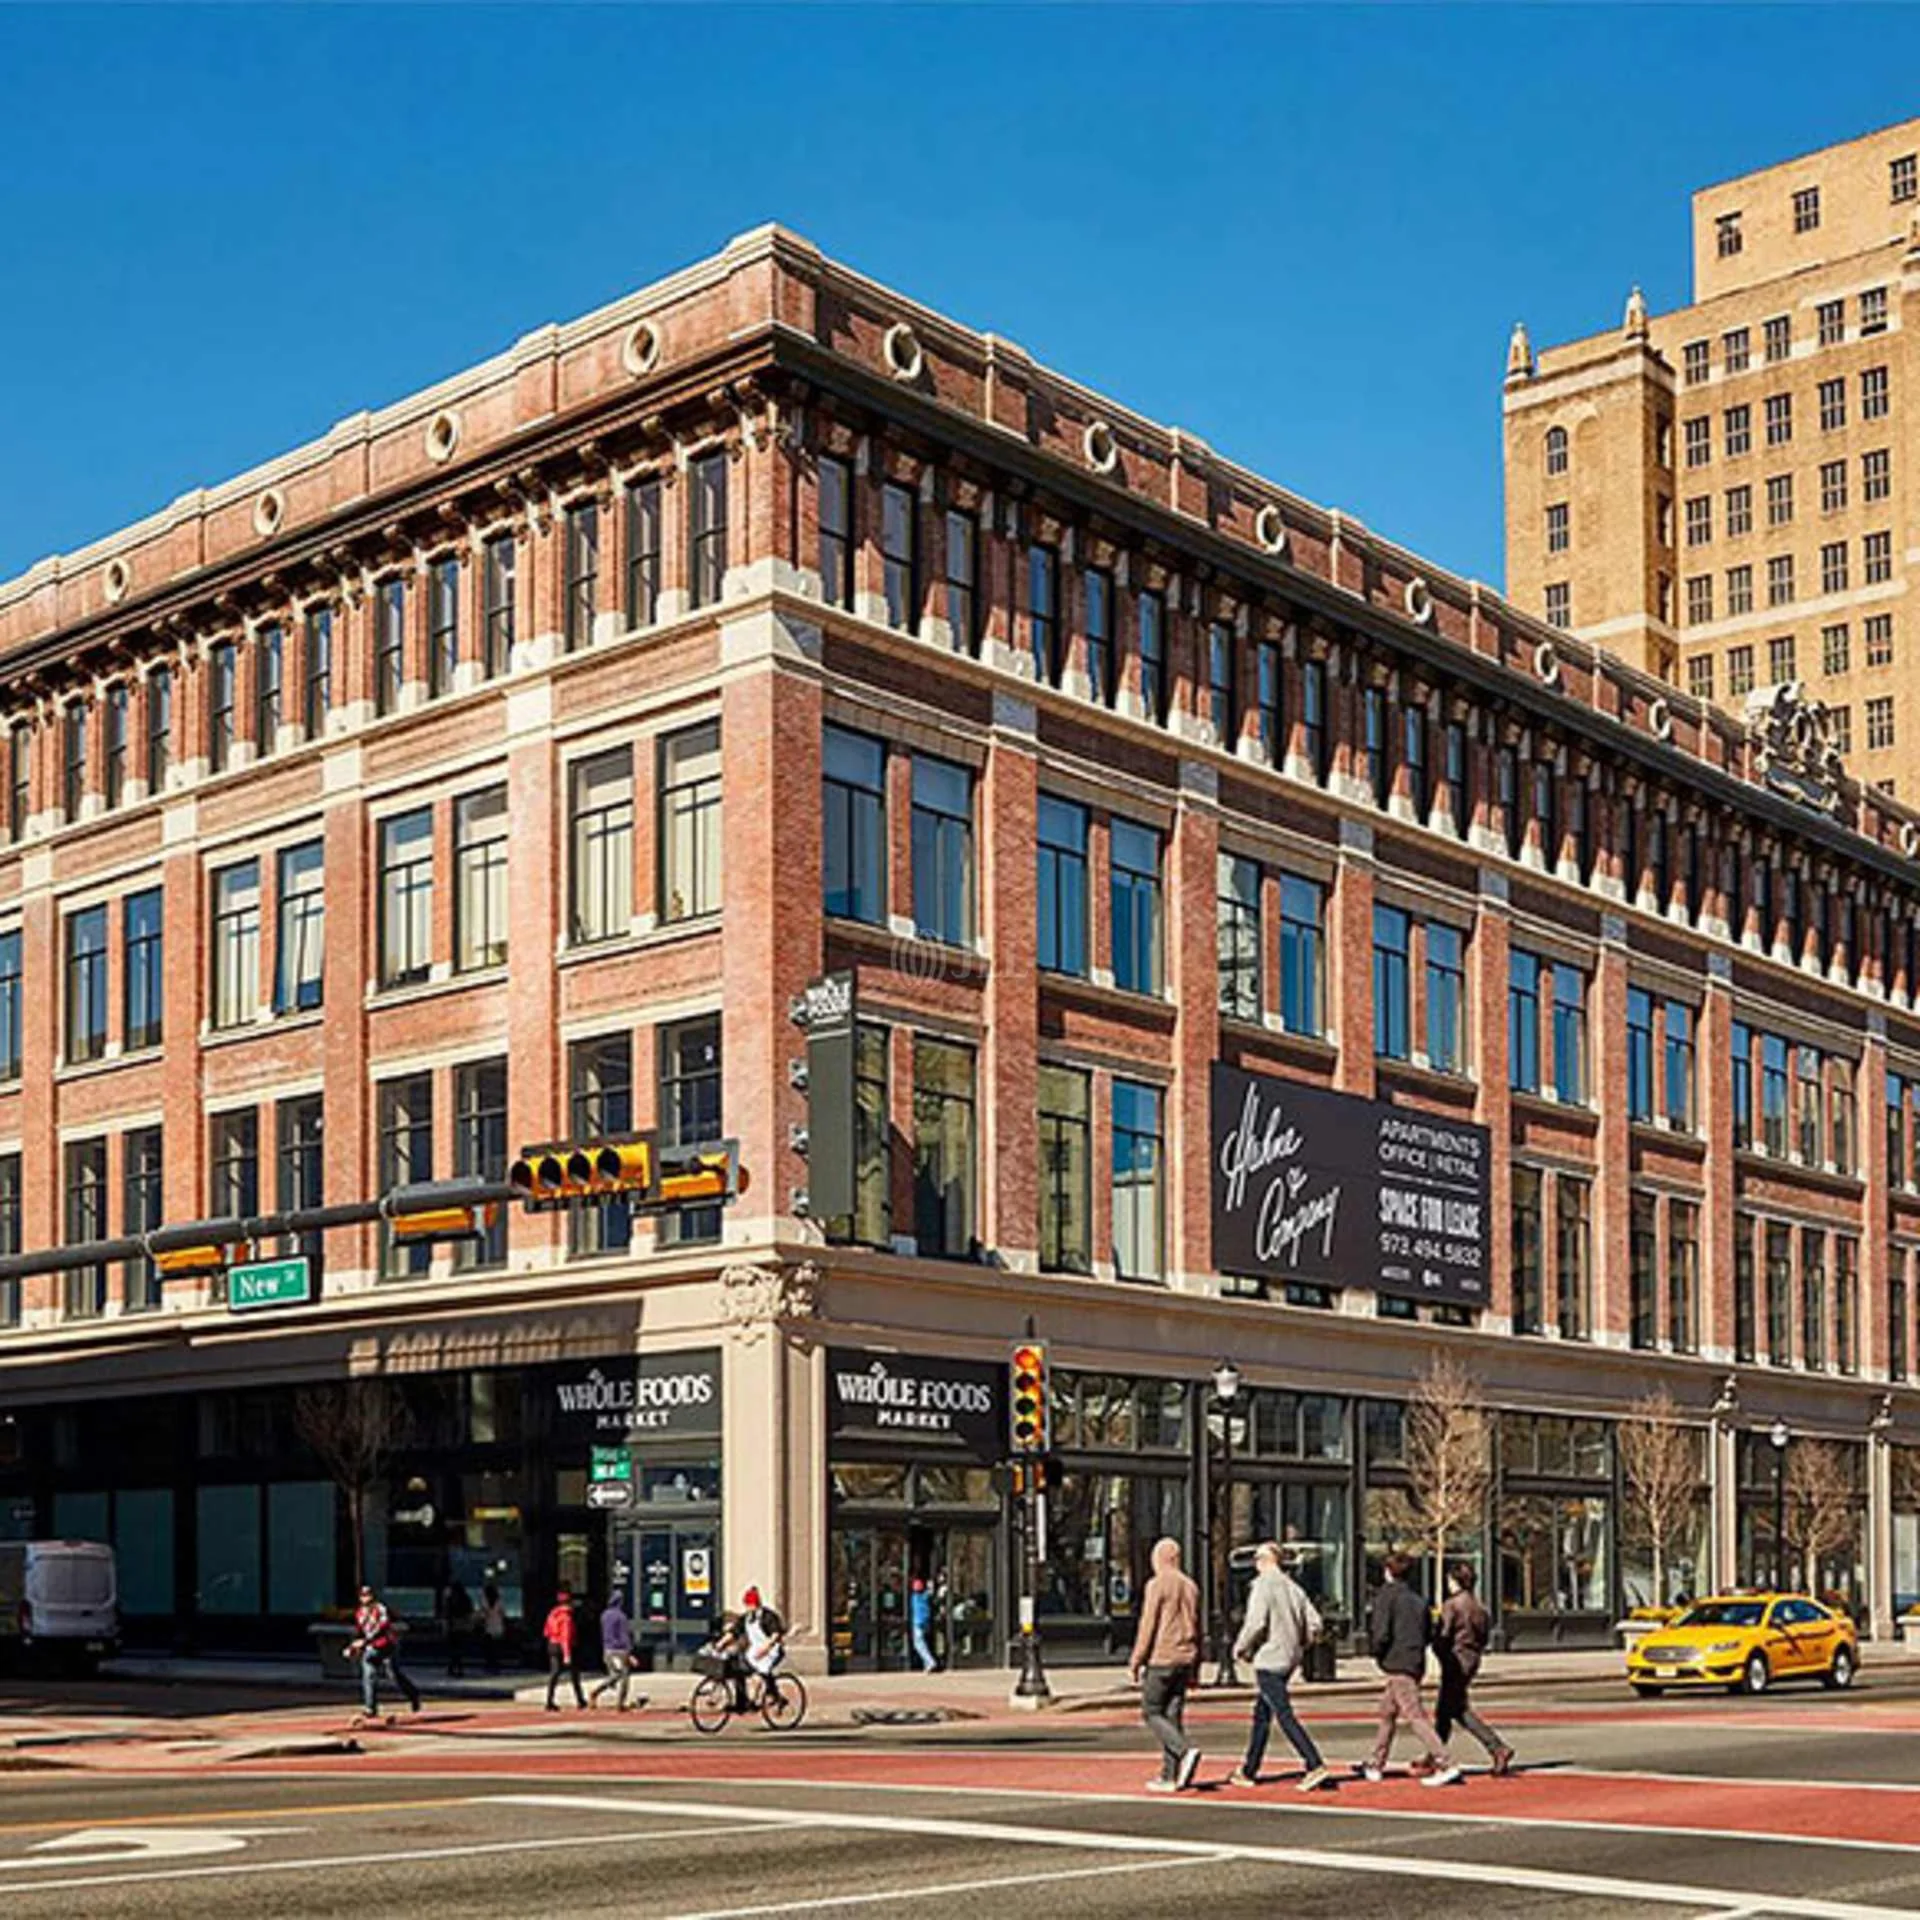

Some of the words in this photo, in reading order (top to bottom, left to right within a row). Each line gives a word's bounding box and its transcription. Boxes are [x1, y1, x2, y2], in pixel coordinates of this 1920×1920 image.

[240, 1274, 280, 1299] New
[557, 1379, 633, 1411] WHOLE
[638, 1374, 712, 1406] FOODS
[836, 1372, 917, 1406] WHOLE
[920, 1381, 991, 1412] FOODS
[596, 1410, 670, 1430] MARKET
[877, 1409, 950, 1429] MARKET
